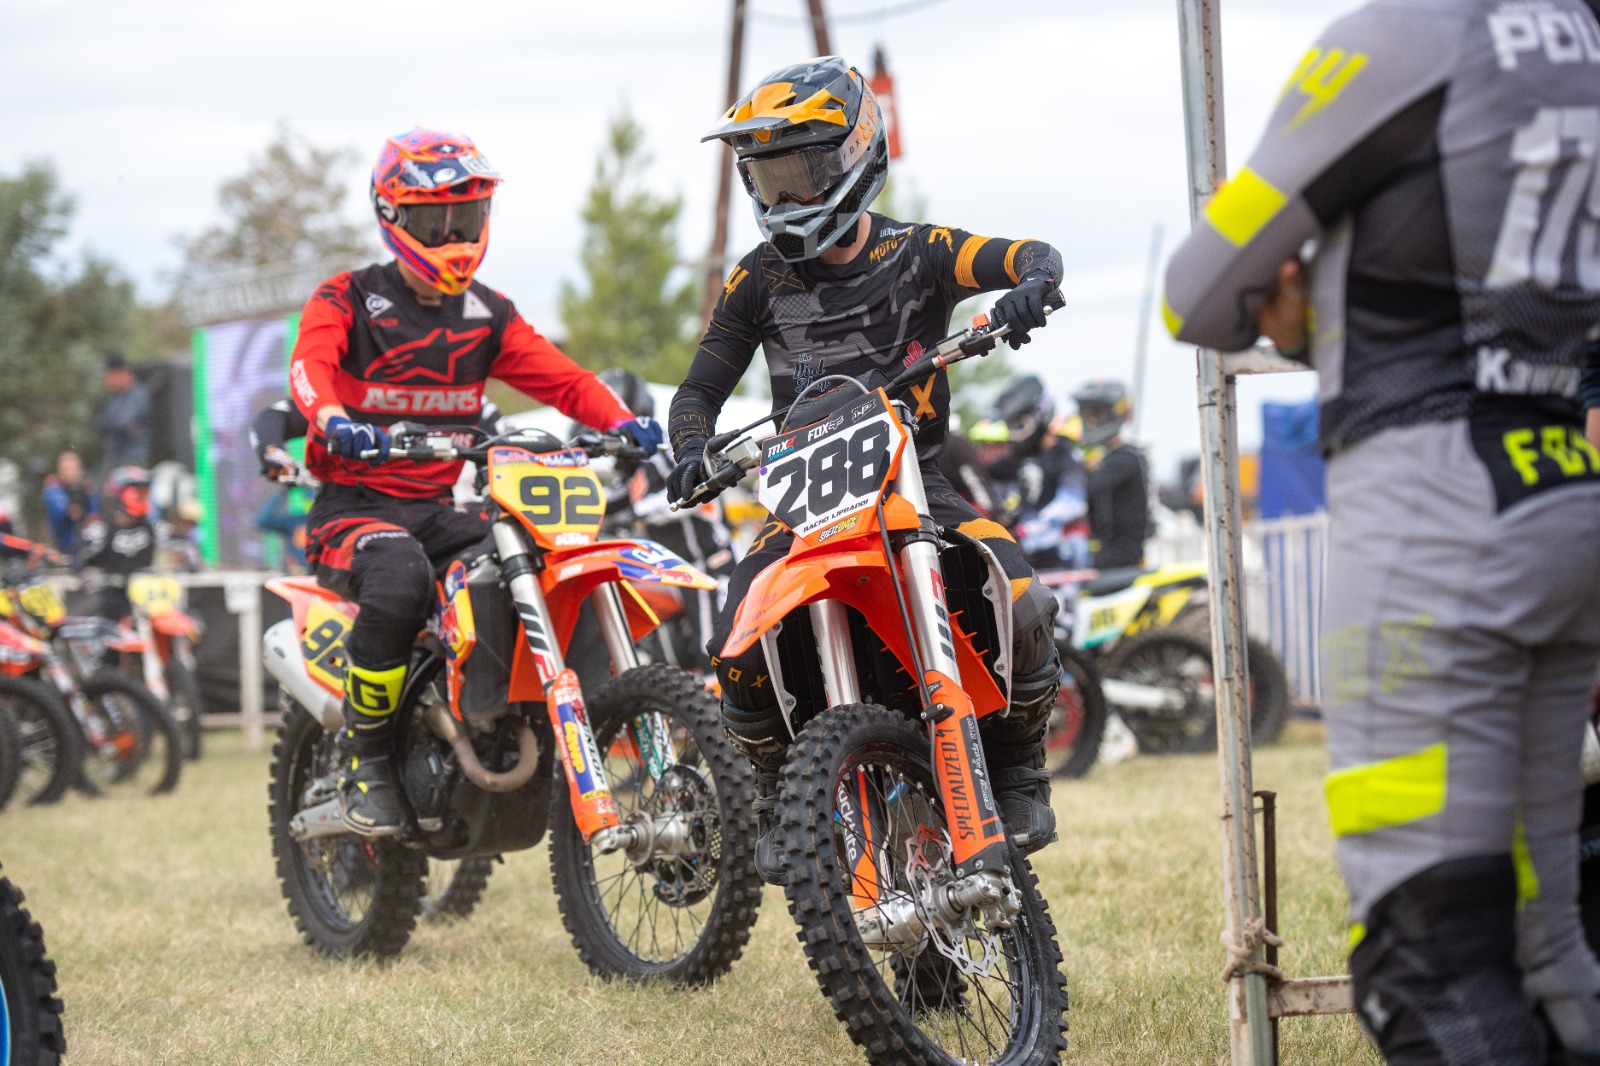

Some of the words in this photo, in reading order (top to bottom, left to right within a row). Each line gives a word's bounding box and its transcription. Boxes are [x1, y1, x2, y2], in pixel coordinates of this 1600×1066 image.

[360, 386, 478, 412] ASTARS
[808, 422, 829, 442] FOX
[767, 419, 891, 531] 288
[519, 475, 600, 526] 92
[555, 531, 590, 546] KTM
[710, 655, 769, 688] FOX
[942, 742, 976, 841] SPECIALIZED
